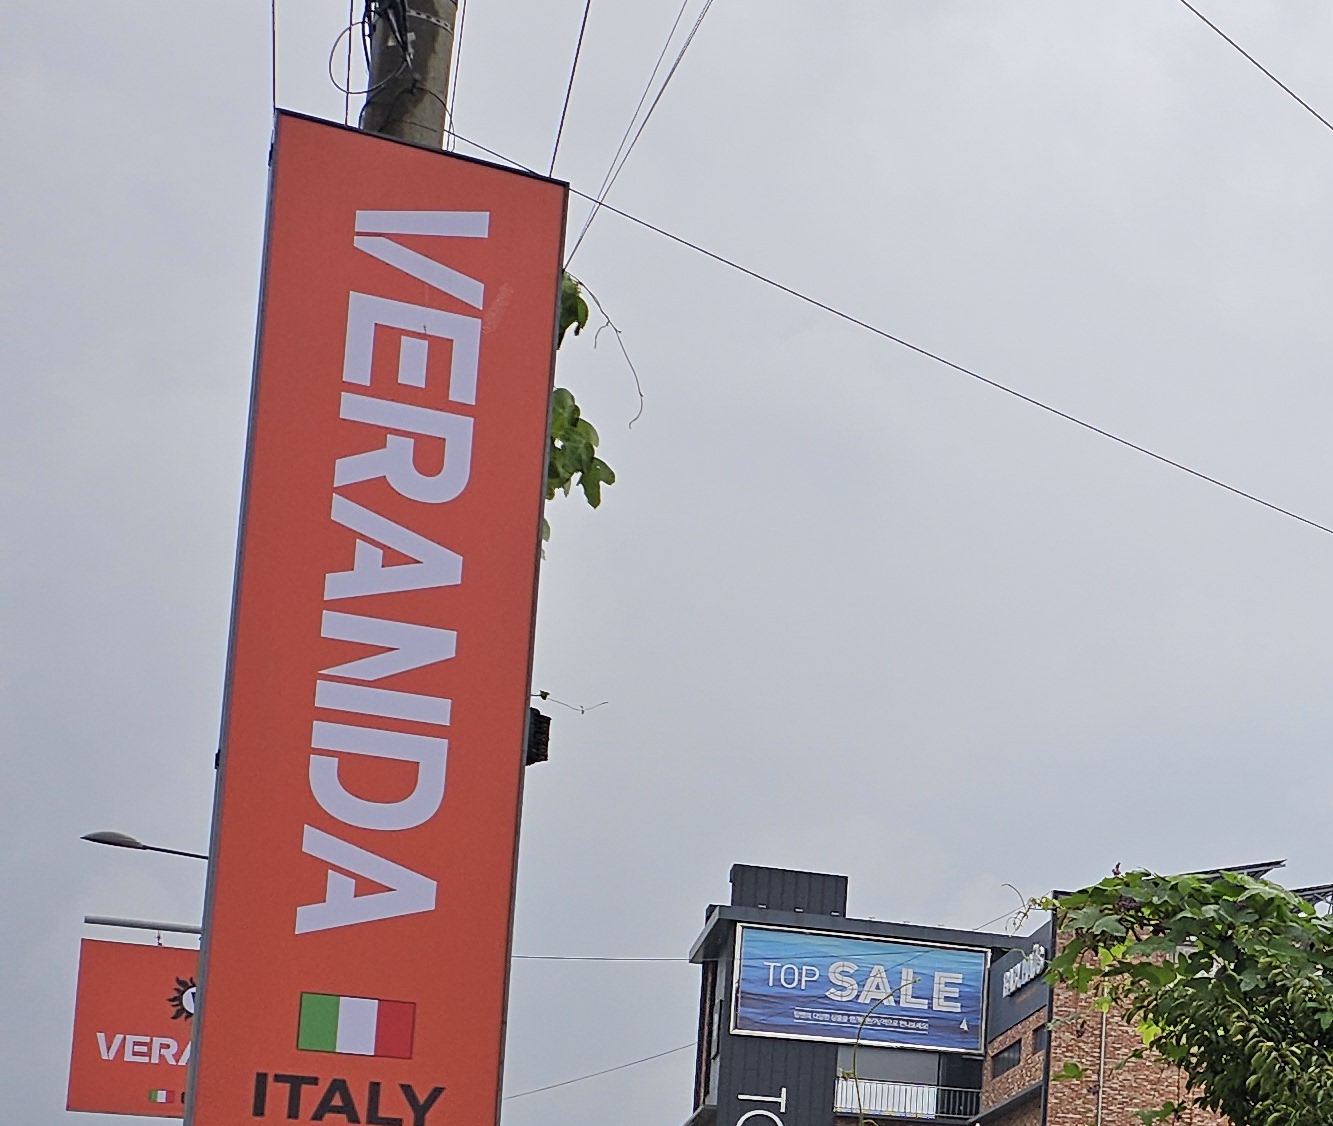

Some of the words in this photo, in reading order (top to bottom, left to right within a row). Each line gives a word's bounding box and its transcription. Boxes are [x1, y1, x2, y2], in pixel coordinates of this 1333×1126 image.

[295, 209, 490, 935] VERANDA
[763, 960, 821, 990] TOP
[824, 960, 964, 1014] SALE
